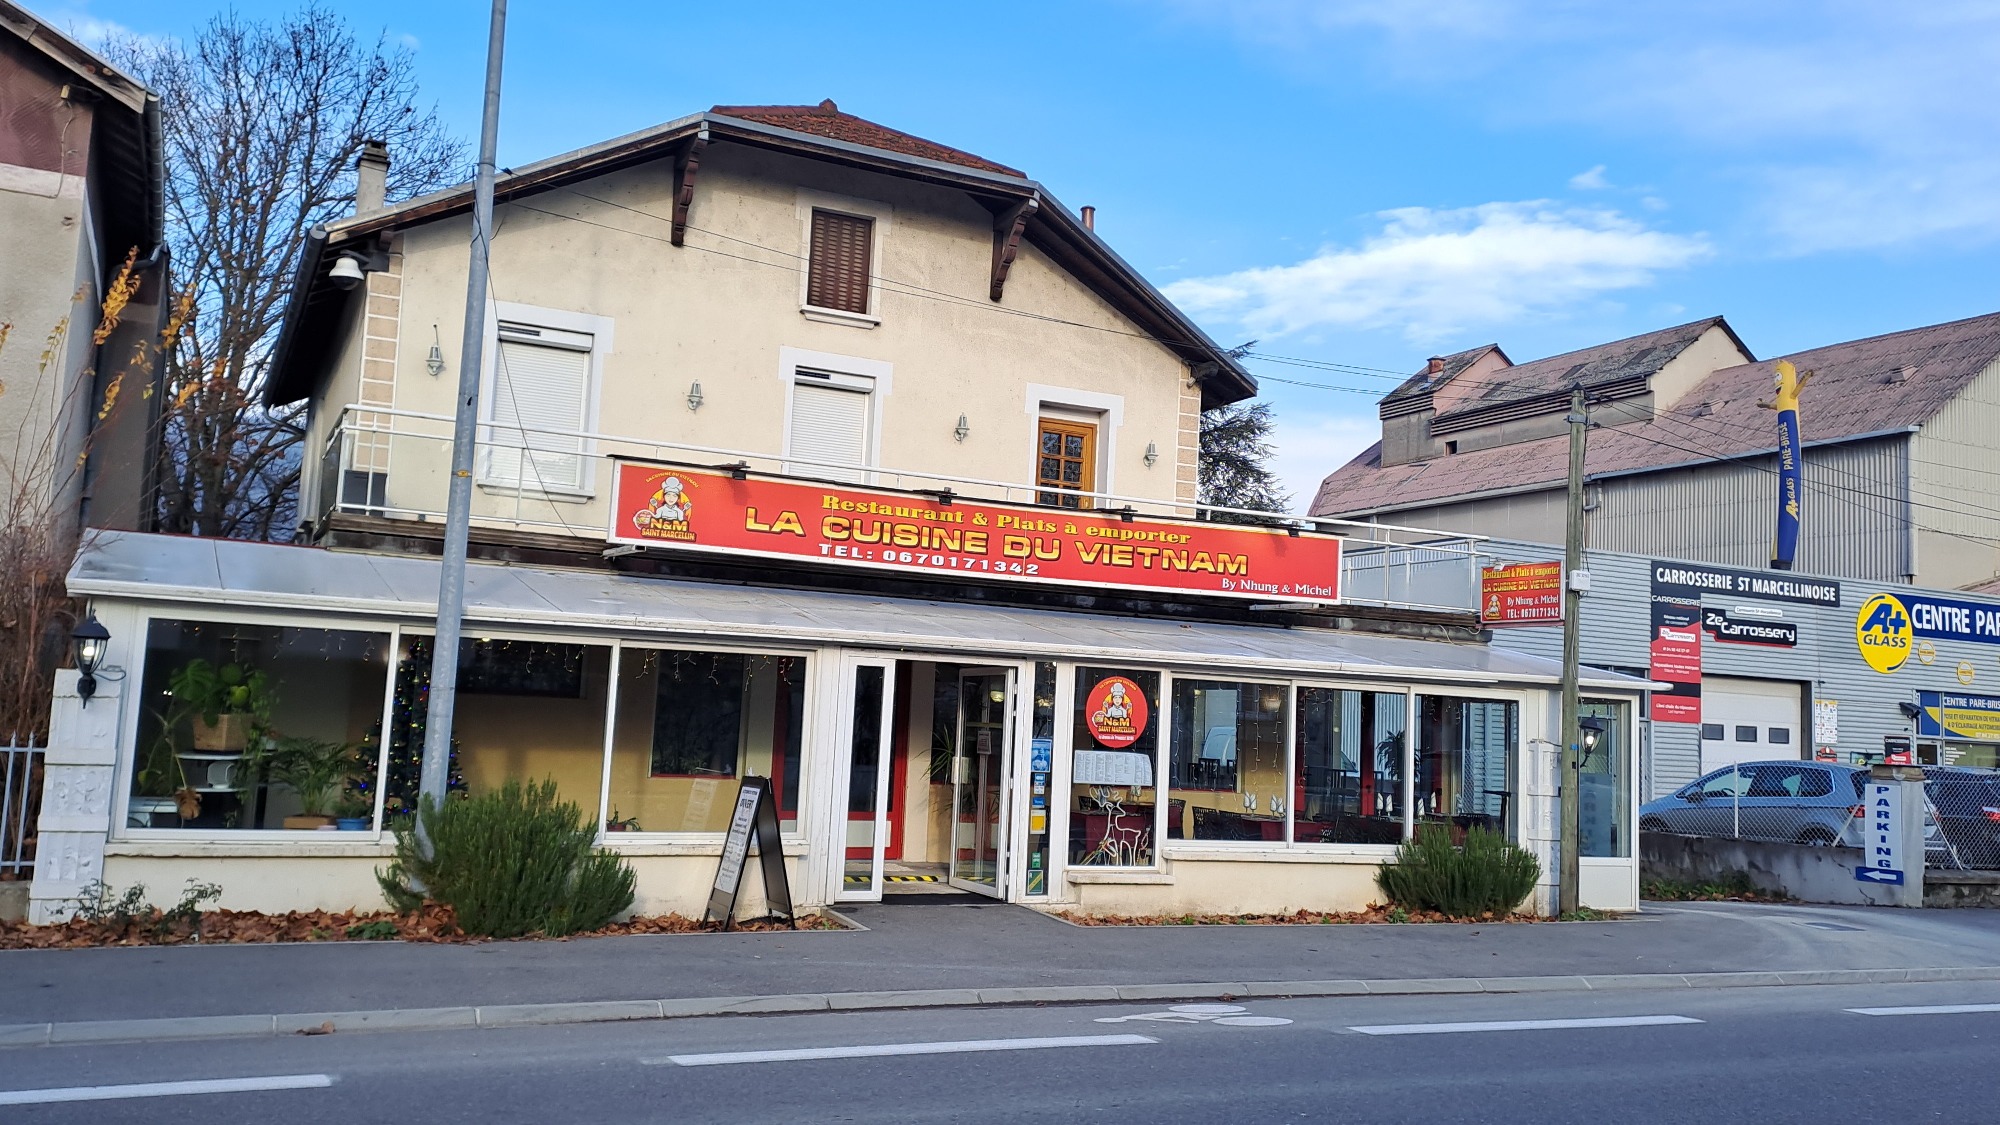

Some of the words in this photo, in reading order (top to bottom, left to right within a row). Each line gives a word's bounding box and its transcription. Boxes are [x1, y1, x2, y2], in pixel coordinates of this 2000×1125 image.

[1779, 421, 1794, 470] PARE-BRISE
[650, 518, 688, 532] N&M
[821, 494, 964, 524] Restaurant
[972, 512, 988, 526] &
[996, 514, 1057, 532] Plats
[1064, 522, 1078, 535] à
[1085, 525, 1191, 544] emporter
[641, 528, 660, 537] SAINT
[660, 530, 695, 541] MARCELLIN
[745, 506, 806, 537] LA
[821, 515, 989, 555] CUISINE
[1003, 534, 1061, 560] DU
[1074, 541, 1248, 576] VIETNAM
[818, 543, 873, 559] TEL:
[882, 550, 1039, 574] 0670171342
[1222, 578, 1236, 591] By
[1240, 579, 1279, 594] Nhung
[1281, 585, 1291, 594] &
[1295, 583, 1332, 597] Michel
[1493, 581, 1518, 592] CUISINE
[1518, 580, 1528, 590] DU
[1530, 578, 1560, 590] VIETNAM
[1656, 567, 1733, 590] CARROSSERIE
[1738, 576, 1750, 592] ST
[1752, 578, 1836, 602] MARCELLINOISE
[1507, 597, 1514, 607] By
[1515, 595, 1534, 606] Nhung
[1541, 594, 1559, 605] Michel
[1651, 595, 1700, 606] CARROSSERIE
[1507, 608, 1520, 619] TEL:
[1861, 603, 1906, 635] A+
[1912, 603, 1971, 634] CENTRE
[1863, 634, 1907, 648] GLASS
[1944, 696, 1967, 707] CENTRE
[1103, 717, 1130, 727] N&M
[1876, 786, 1892, 869] PARKING
